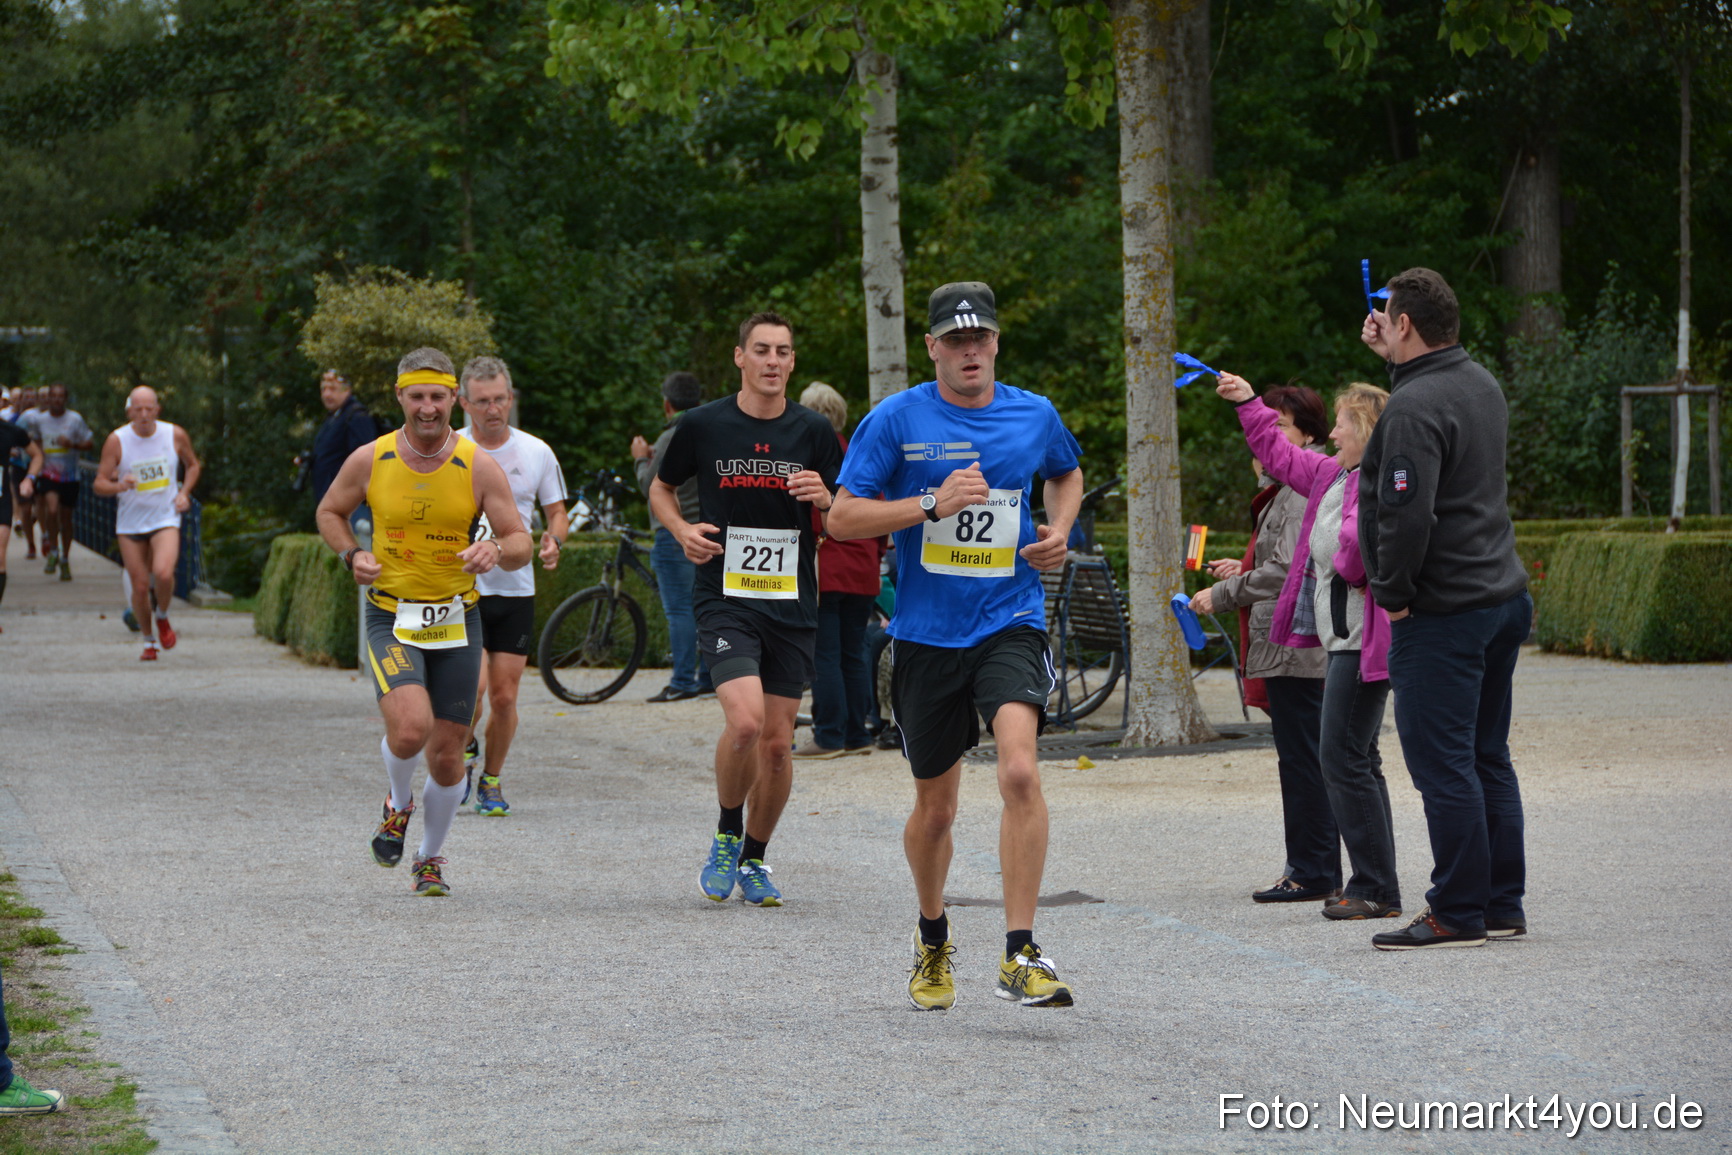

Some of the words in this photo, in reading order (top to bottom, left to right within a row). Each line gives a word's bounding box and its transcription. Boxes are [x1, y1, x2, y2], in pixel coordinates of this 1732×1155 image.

[140, 465, 164, 481] 534
[716, 459, 803, 477] UNDER
[955, 510, 994, 543] 82
[728, 533, 754, 542] PARTL
[741, 545, 784, 572] 221
[951, 551, 992, 564] Harald
[741, 577, 782, 589] Matthias
[421, 606, 449, 628] 92
[411, 629, 447, 641] Michael
